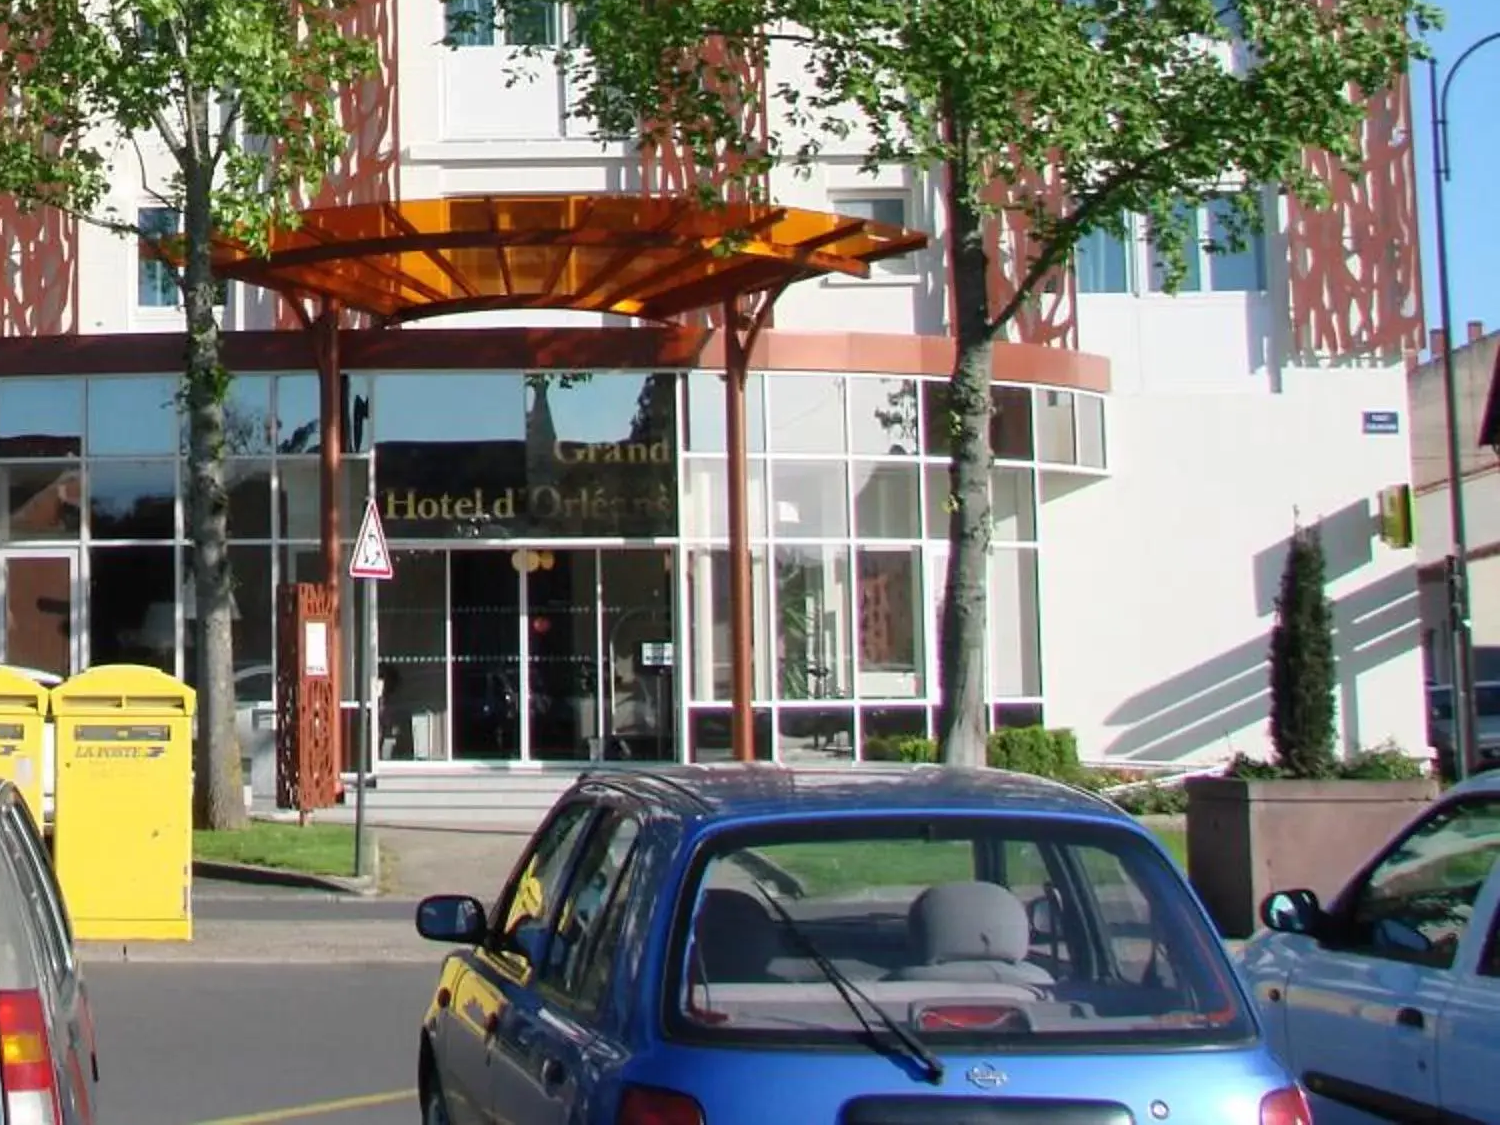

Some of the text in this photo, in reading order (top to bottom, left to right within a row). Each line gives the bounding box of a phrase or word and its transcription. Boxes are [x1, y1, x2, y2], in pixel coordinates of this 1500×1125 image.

[553, 438, 671, 465] Grand
[384, 487, 485, 521] Hotel
[97, 746, 142, 758] POSTE
